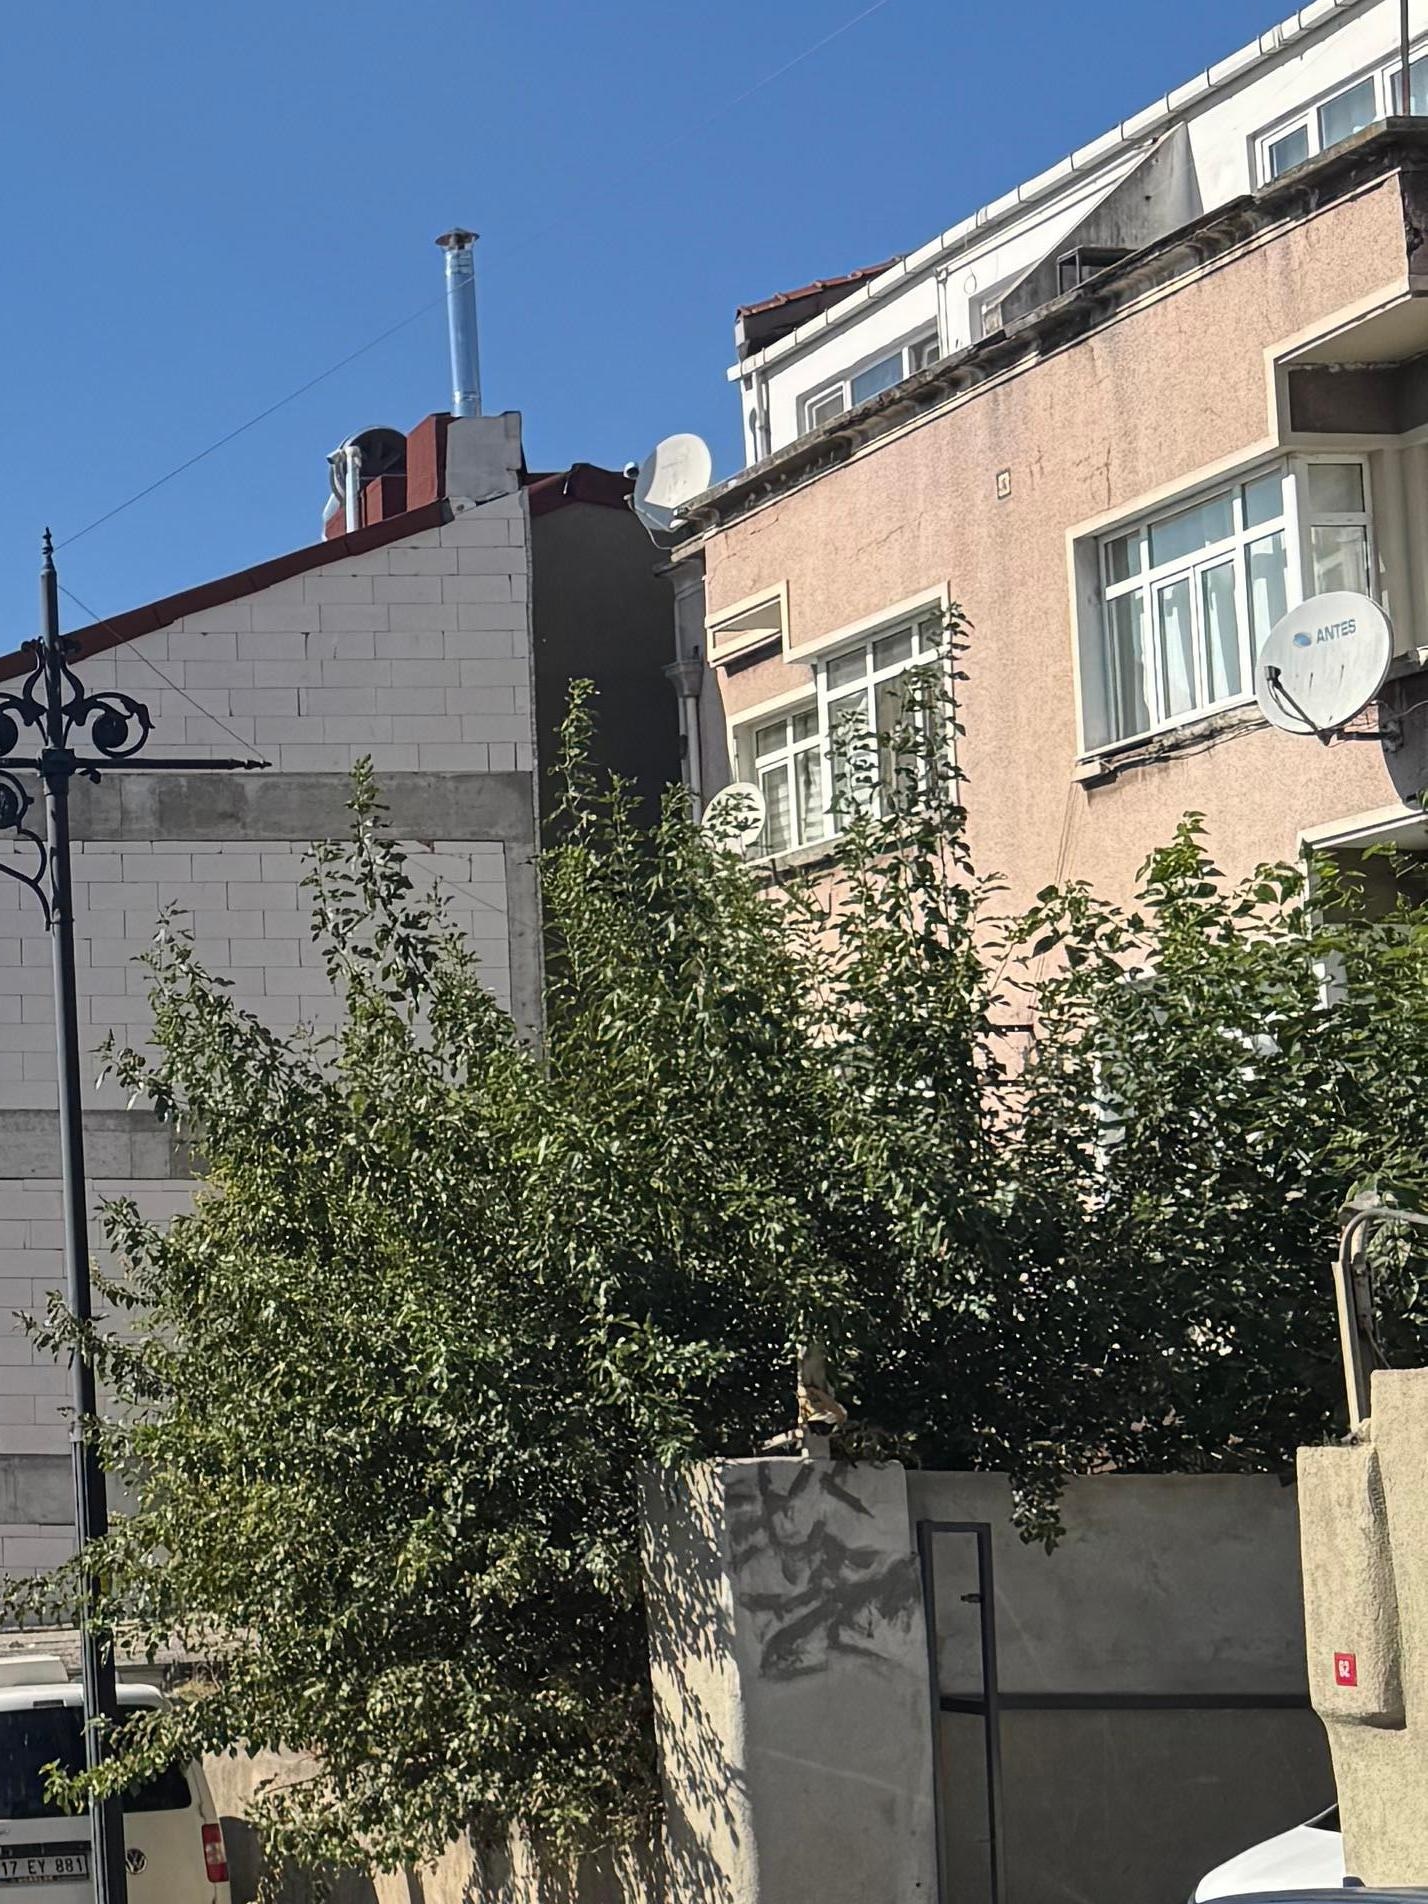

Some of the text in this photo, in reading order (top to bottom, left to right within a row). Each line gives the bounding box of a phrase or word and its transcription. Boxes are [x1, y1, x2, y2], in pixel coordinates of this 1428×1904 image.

[1317, 619, 1356, 644] ANTES
[2, 1857, 83, 1876] 17 EY 881
